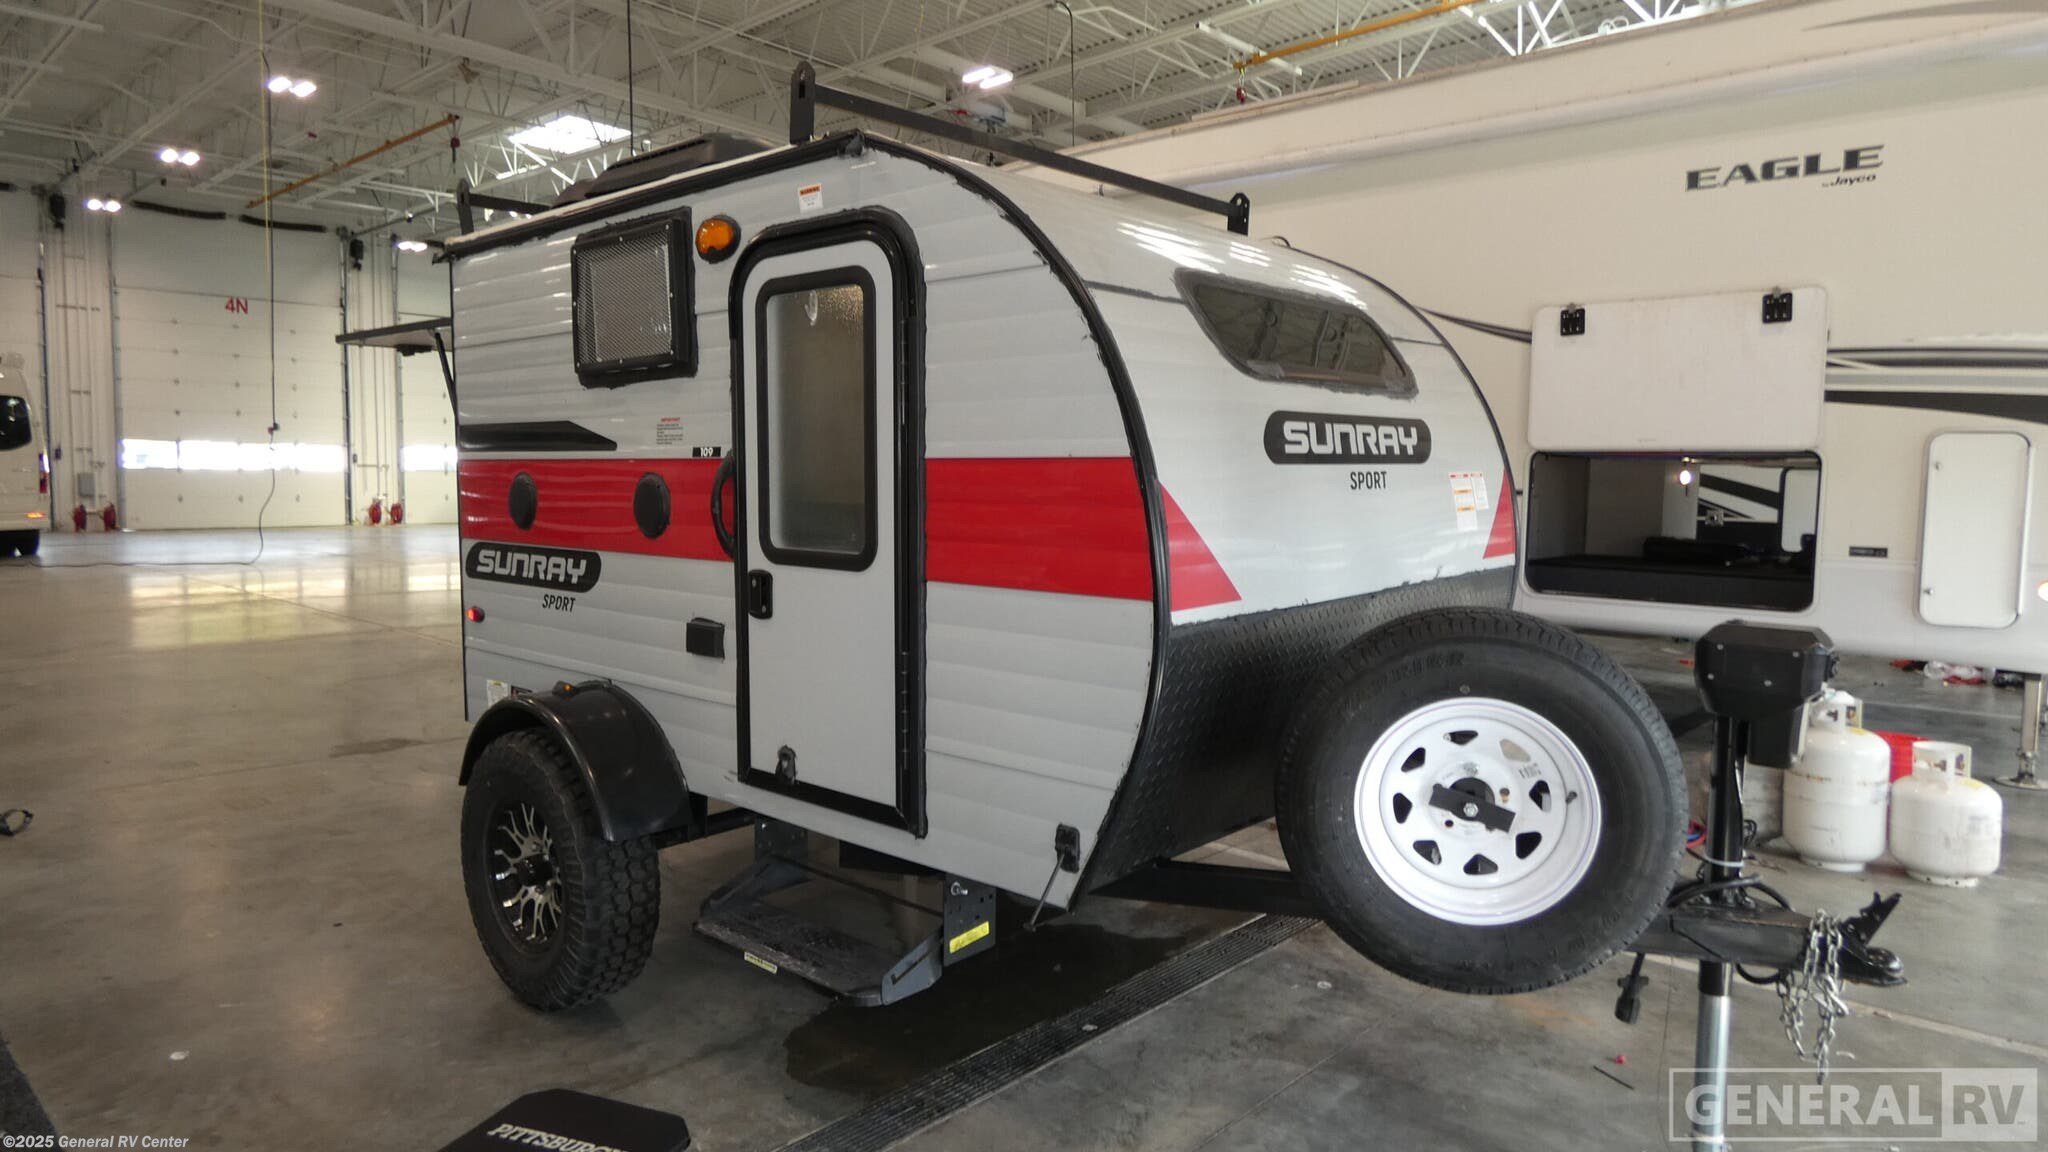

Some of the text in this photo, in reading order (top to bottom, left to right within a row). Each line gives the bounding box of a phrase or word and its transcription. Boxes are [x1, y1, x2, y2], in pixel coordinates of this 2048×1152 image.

[1685, 145, 1885, 191] EAGLE
[1831, 174, 1877, 187] Jayco
[225, 297, 249, 315] 4N
[1283, 420, 1418, 456] SUNRAY
[700, 447, 714, 457] 109
[1350, 471, 1387, 490] SPORT
[476, 550, 587, 584] SUNRAY
[542, 594, 576, 612] SPORT
